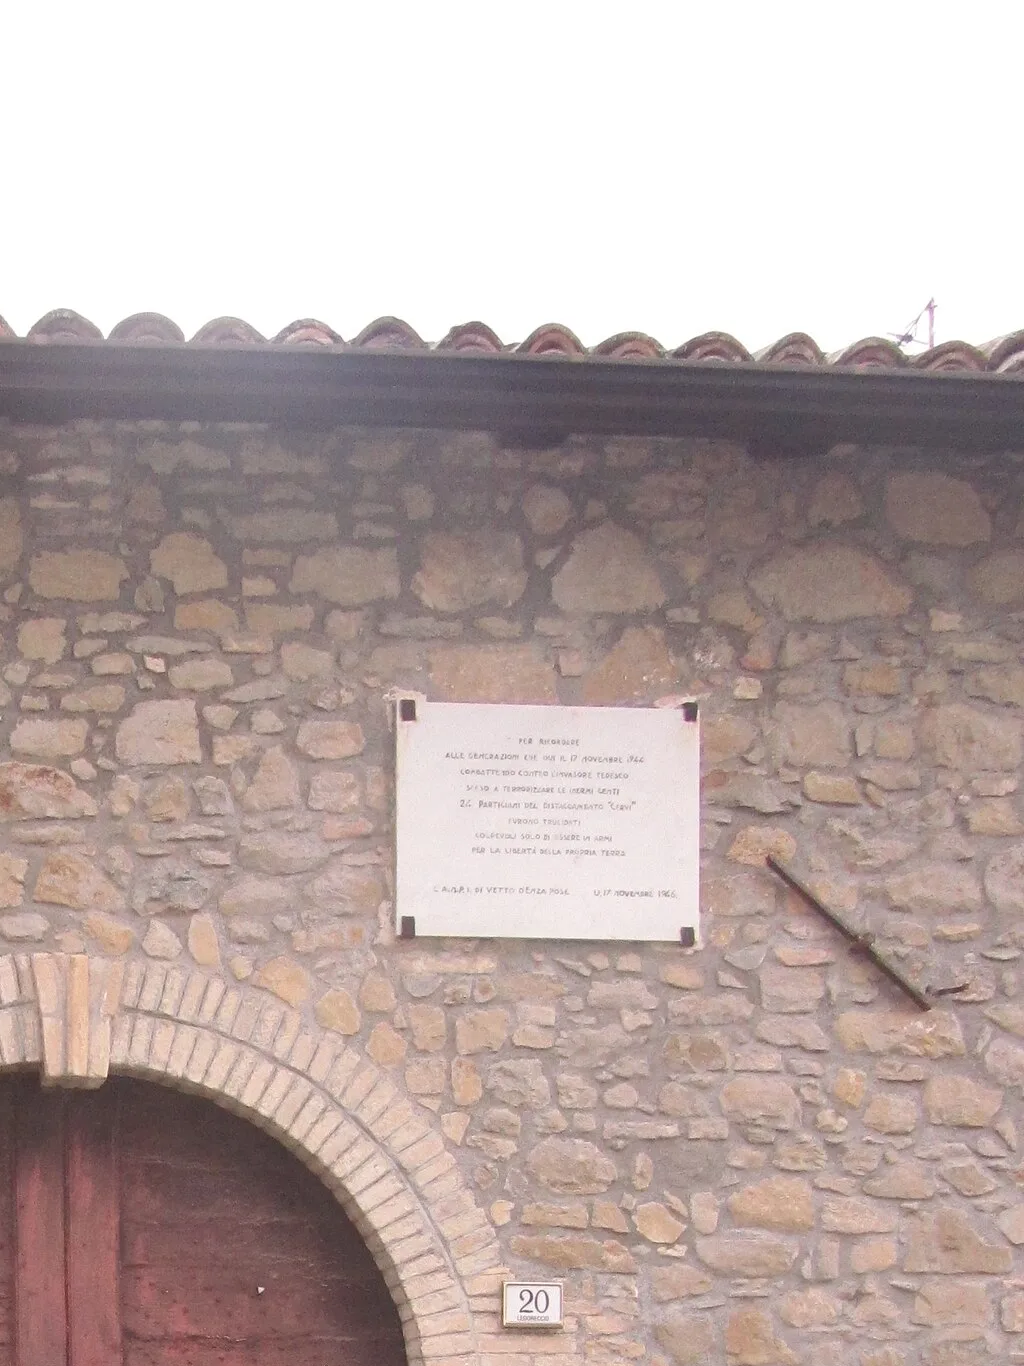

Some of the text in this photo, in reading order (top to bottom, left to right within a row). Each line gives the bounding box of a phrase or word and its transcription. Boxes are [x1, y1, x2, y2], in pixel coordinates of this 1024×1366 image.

[518, 737, 533, 745] PER
[445, 752, 465, 760] ALLE
[581, 756, 623, 764] NOVEMBRE
[596, 772, 629, 780] TEDESCO
[597, 787, 620, 795] GENTI
[478, 800, 520, 809] PARTIGIANI
[471, 846, 486, 854] PER
[540, 848, 562, 856] DELLA
[565, 849, 597, 857] PROPRIA
[601, 849, 626, 857] TERRA
[613, 890, 654, 898] NOVEMBRE
[518, 1289, 550, 1313] 20
